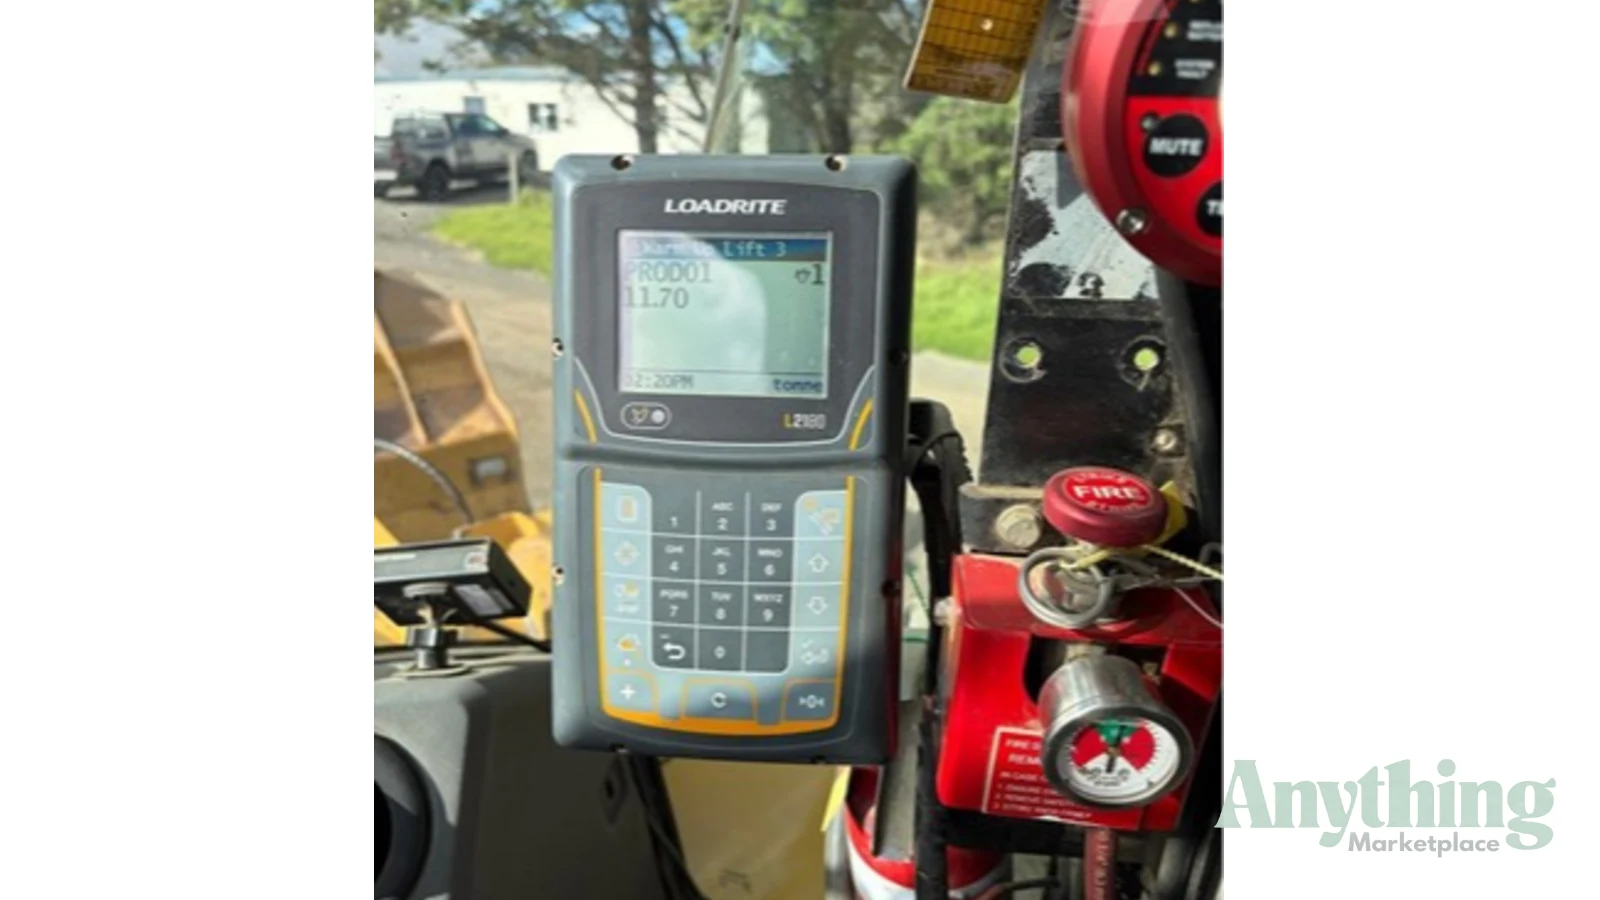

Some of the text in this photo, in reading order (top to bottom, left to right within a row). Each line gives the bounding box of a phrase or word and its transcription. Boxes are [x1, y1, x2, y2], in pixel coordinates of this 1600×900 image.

[1150, 138, 1203, 156] MUTE
[664, 199, 787, 215] LOADRITE
[723, 241, 766, 257] Lift
[775, 241, 787, 257] 3
[625, 261, 711, 284] PROD01
[812, 264, 824, 285] 1
[625, 286, 690, 309] 11.70
[1072, 485, 1142, 500] FIRE
[670, 516, 678, 527] 1
[717, 517, 728, 530] 2
[766, 518, 777, 531] 3
[669, 561, 680, 572] 4
[716, 562, 727, 576] 5
[764, 563, 776, 576] 6
[669, 604, 679, 617] 7
[715, 607, 726, 620] 8
[763, 608, 774, 622] 9
